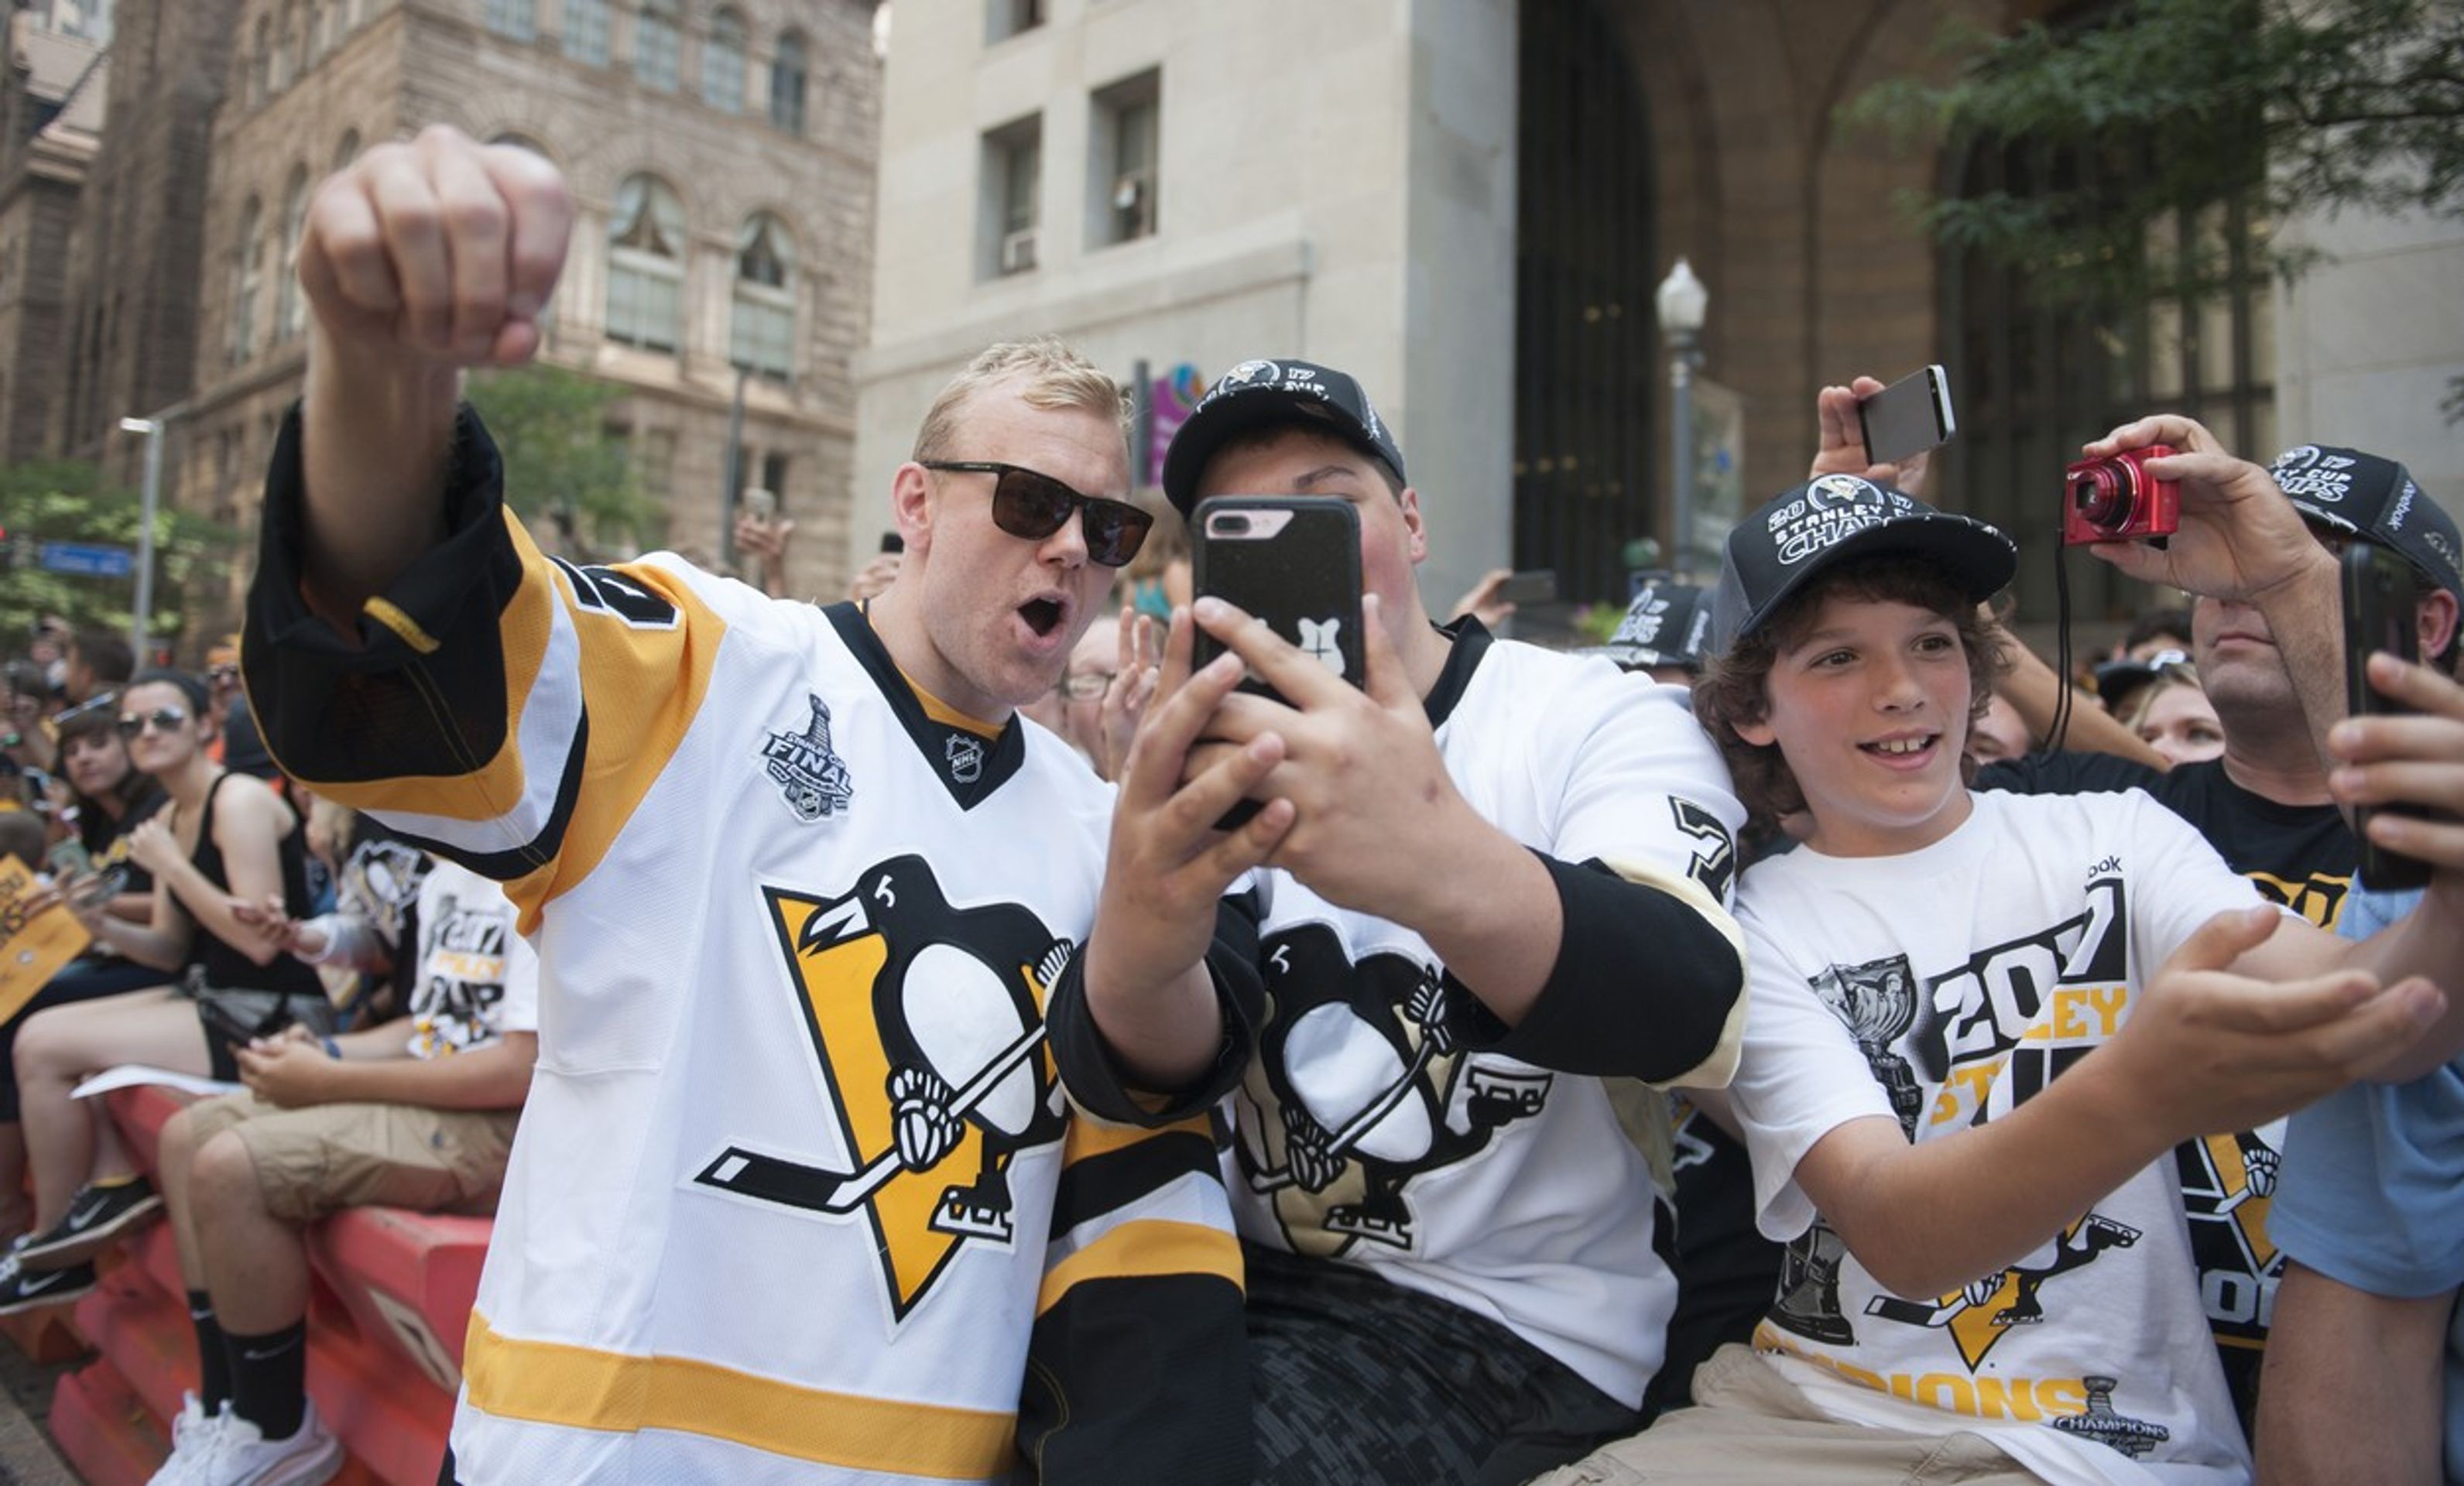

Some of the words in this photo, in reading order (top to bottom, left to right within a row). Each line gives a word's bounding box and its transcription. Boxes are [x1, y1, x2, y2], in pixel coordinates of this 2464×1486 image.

[2305, 468, 2352, 482] CUP
[1768, 499, 1805, 532] 20
[1774, 504, 1883, 545] STANLEY
[766, 735, 853, 795] FINAL
[2056, 1416, 2169, 1441] CHAMPIONS
